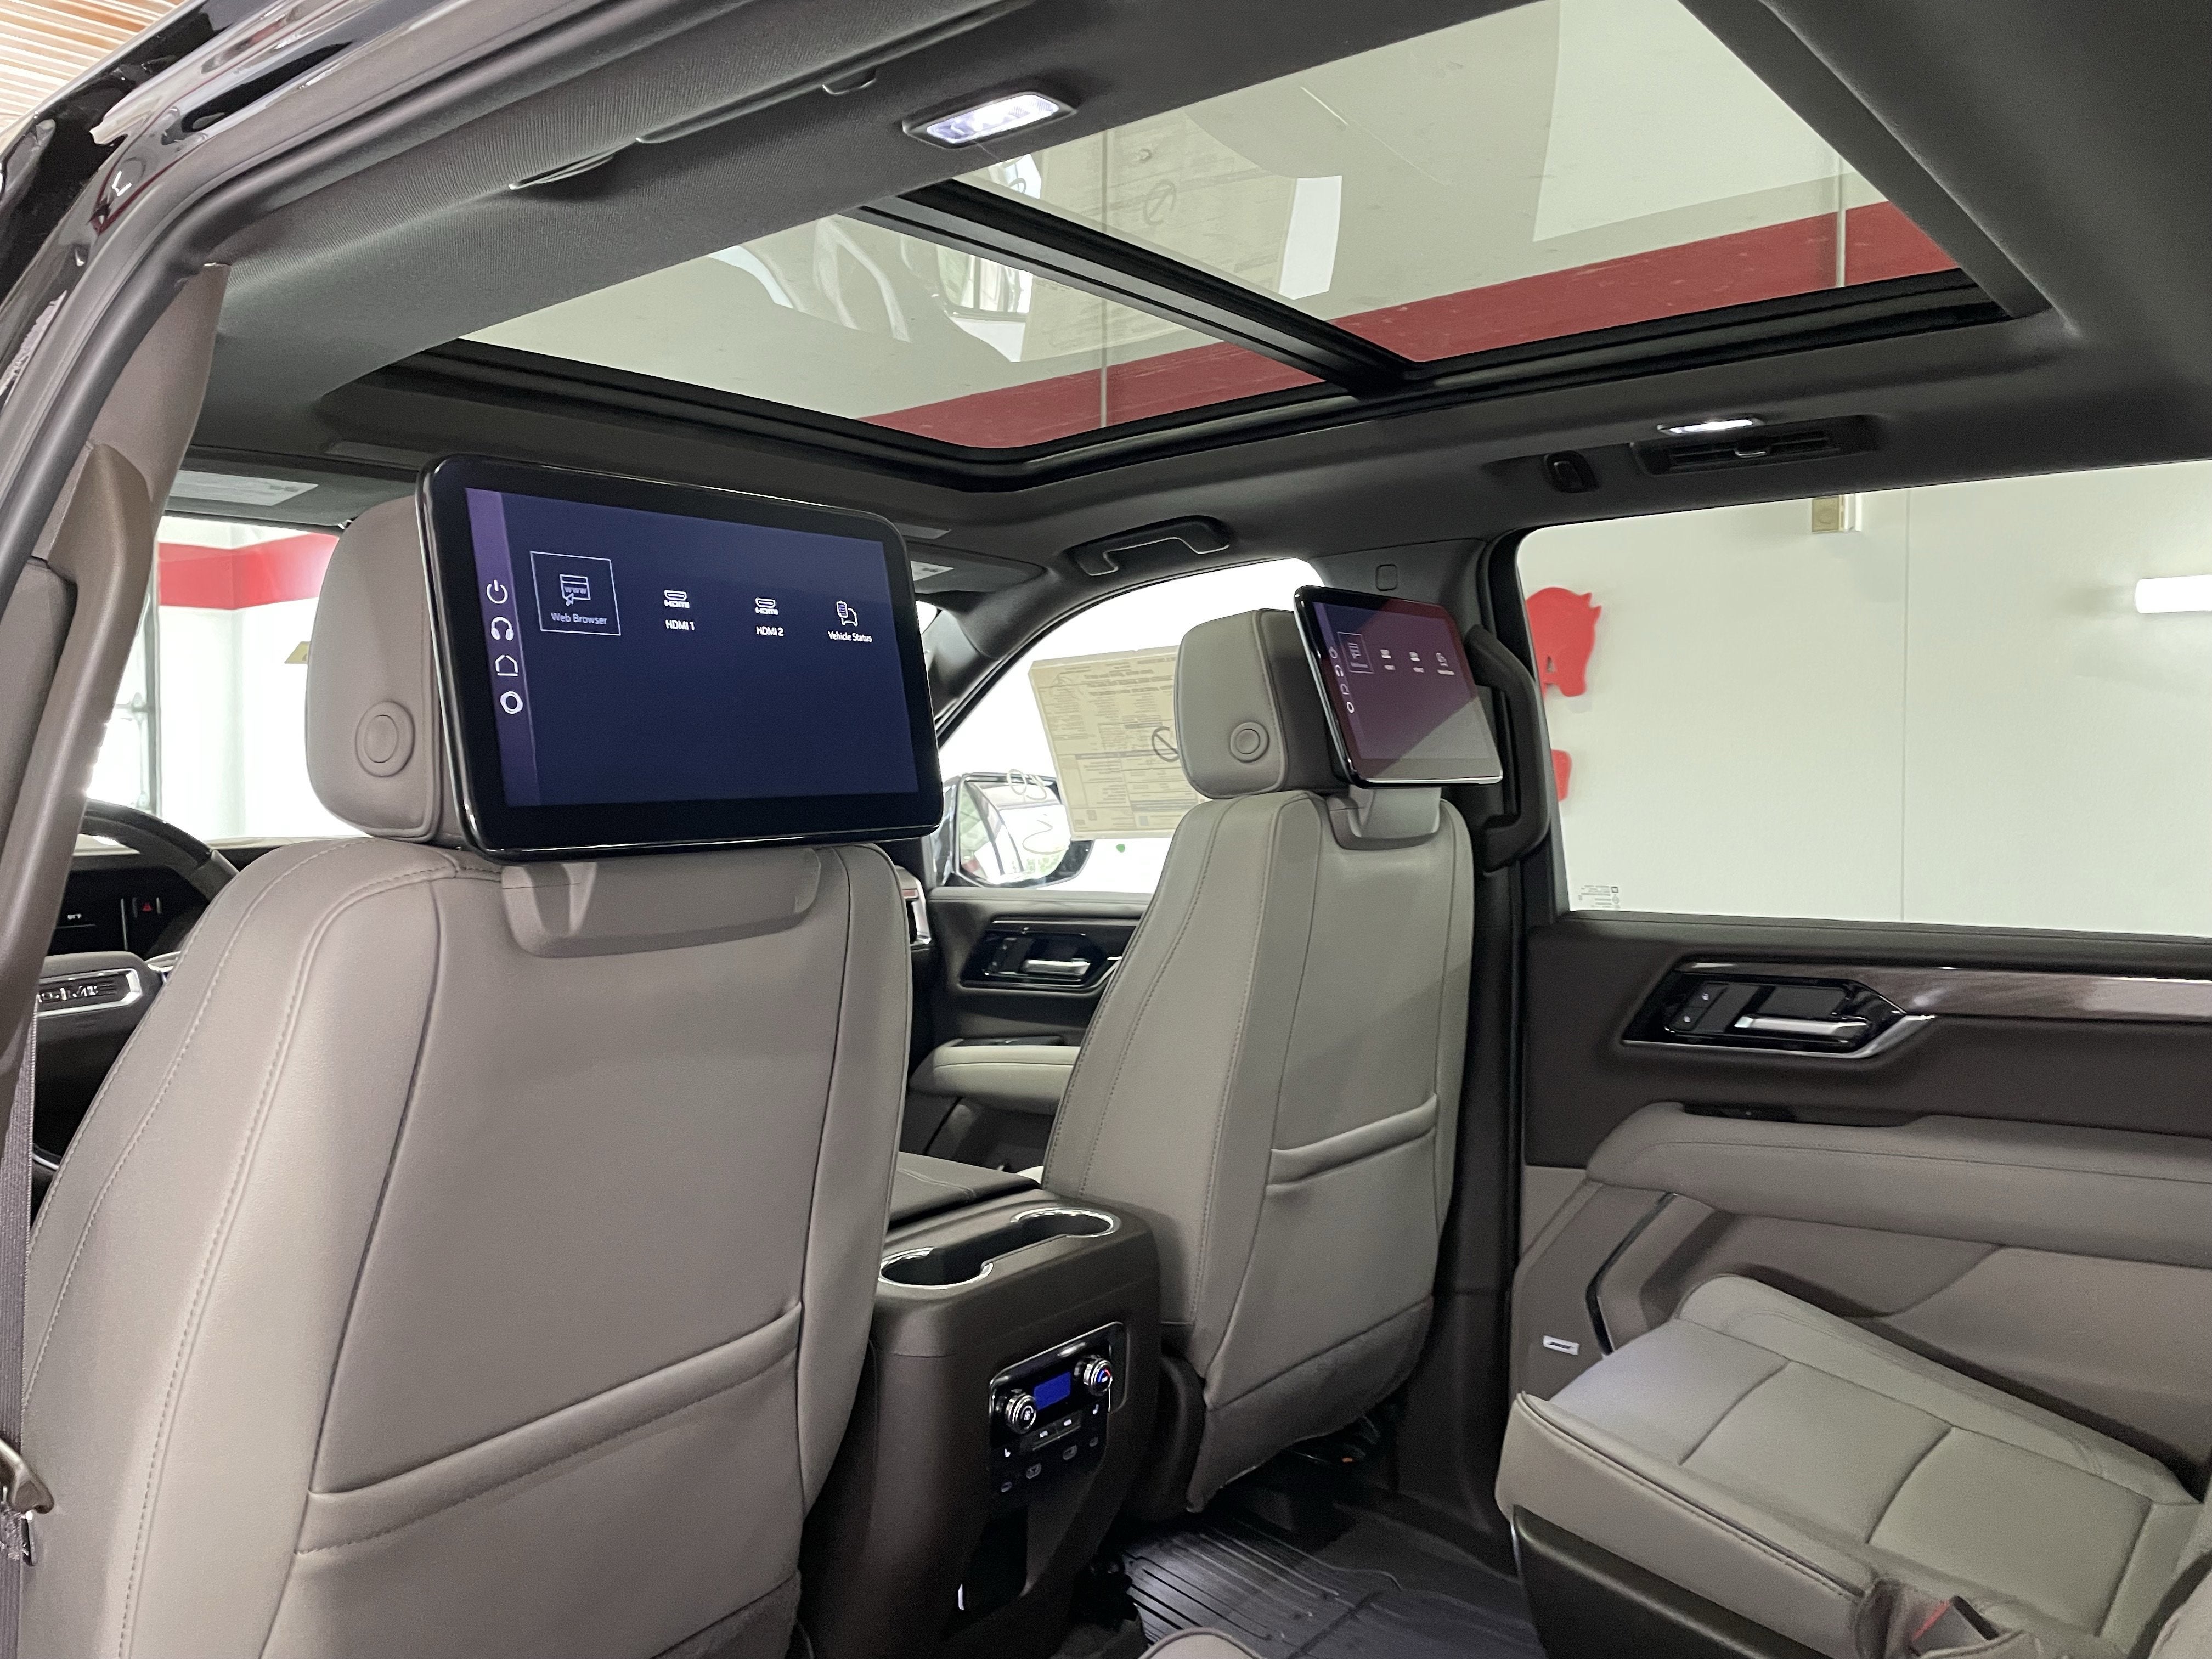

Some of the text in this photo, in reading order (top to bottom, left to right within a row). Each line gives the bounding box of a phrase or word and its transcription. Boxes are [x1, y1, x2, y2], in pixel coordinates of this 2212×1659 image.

[551, 612, 607, 625] Web Browser
[665, 619, 695, 630] HDMI 1
[756, 626, 784, 637] HDMI 2
[827, 631, 873, 642] Vehicle Status
